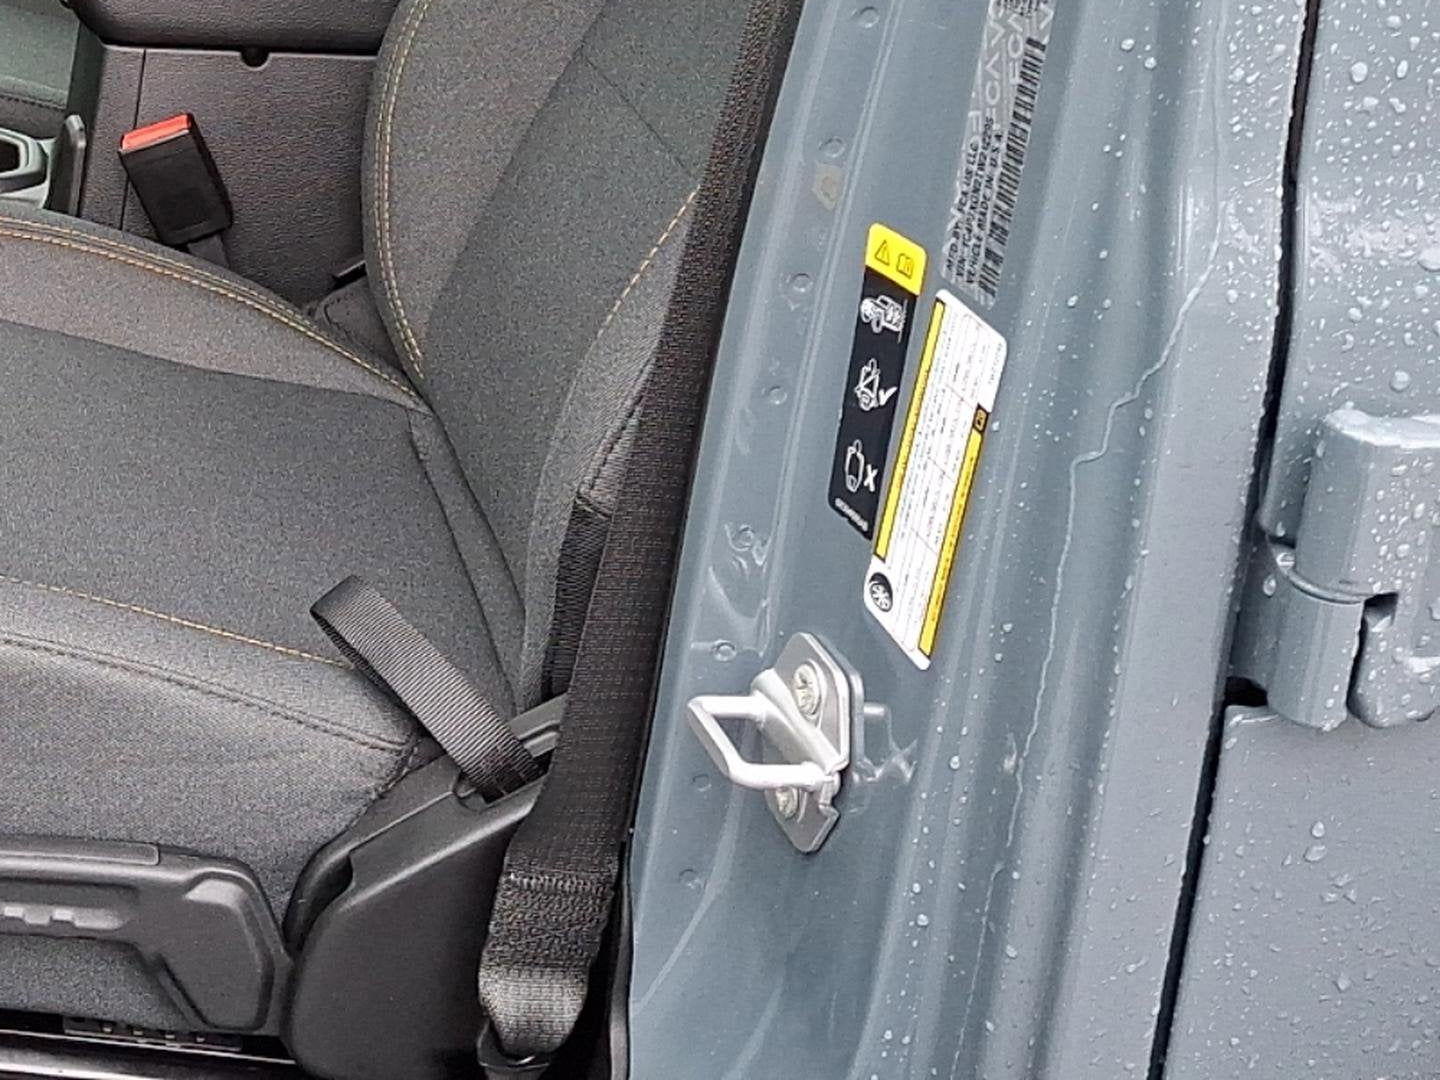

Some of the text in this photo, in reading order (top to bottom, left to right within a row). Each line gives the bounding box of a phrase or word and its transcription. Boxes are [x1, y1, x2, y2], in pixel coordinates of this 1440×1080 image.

[966, 142, 979, 165] LLC
[963, 167, 974, 187] US
[957, 190, 969, 215] FCA
[966, 235, 983, 284] VEHICLE
[977, 193, 991, 231] MADE
